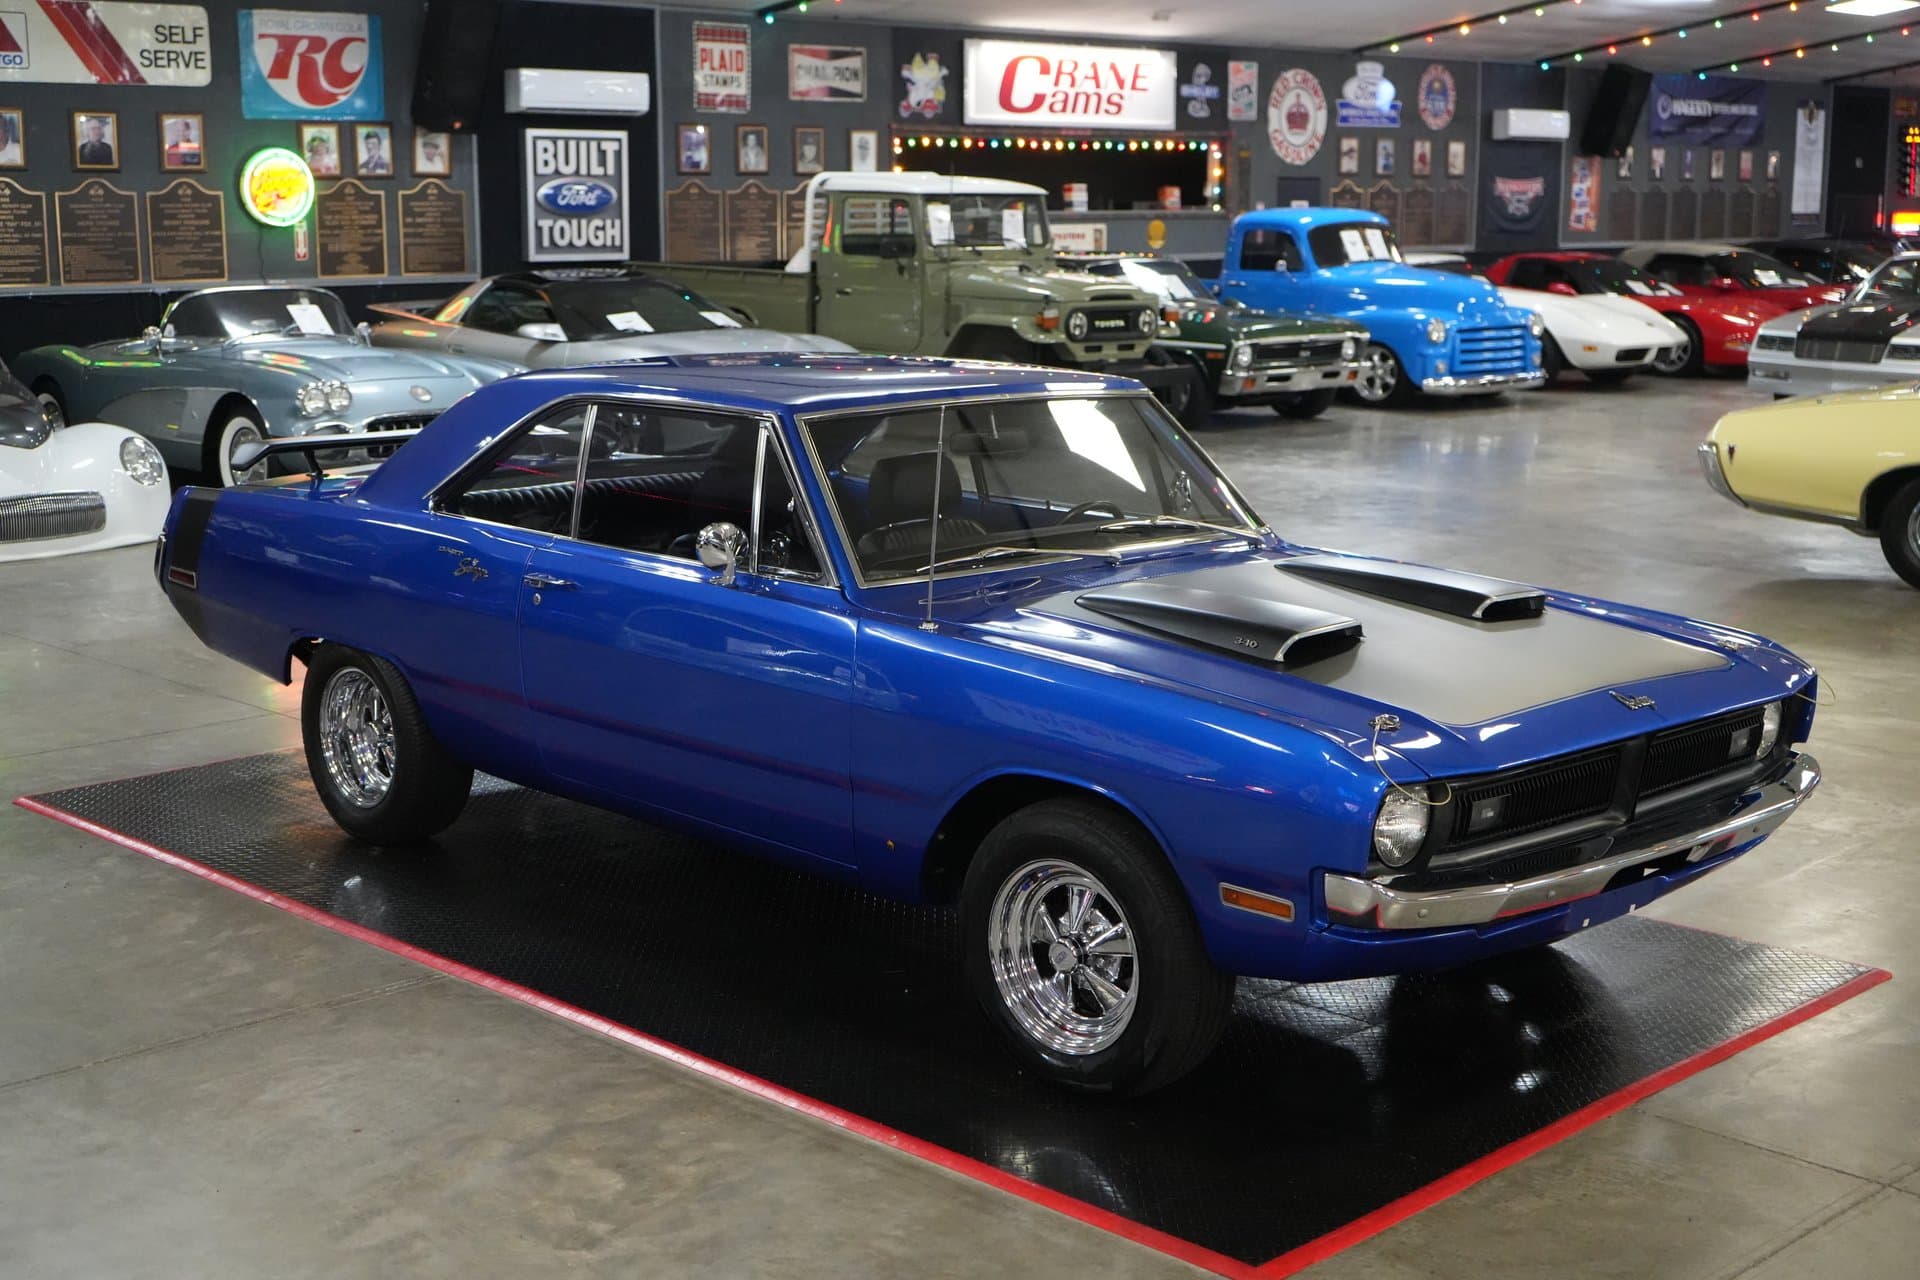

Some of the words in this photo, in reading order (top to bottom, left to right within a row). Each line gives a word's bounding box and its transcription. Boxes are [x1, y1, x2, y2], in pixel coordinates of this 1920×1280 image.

[154, 25, 204, 44] SELF
[140, 49, 206, 69] SERVE
[700, 48, 745, 72] PLAID
[258, 34, 366, 106] RC
[703, 74, 741, 88] STAMPS
[535, 139, 620, 176] BUILT
[556, 184, 602, 206] Ford
[537, 218, 621, 248] TOUGH
[1094, 319, 1126, 328] TOYOTA
[1234, 636, 1258, 648] 340
